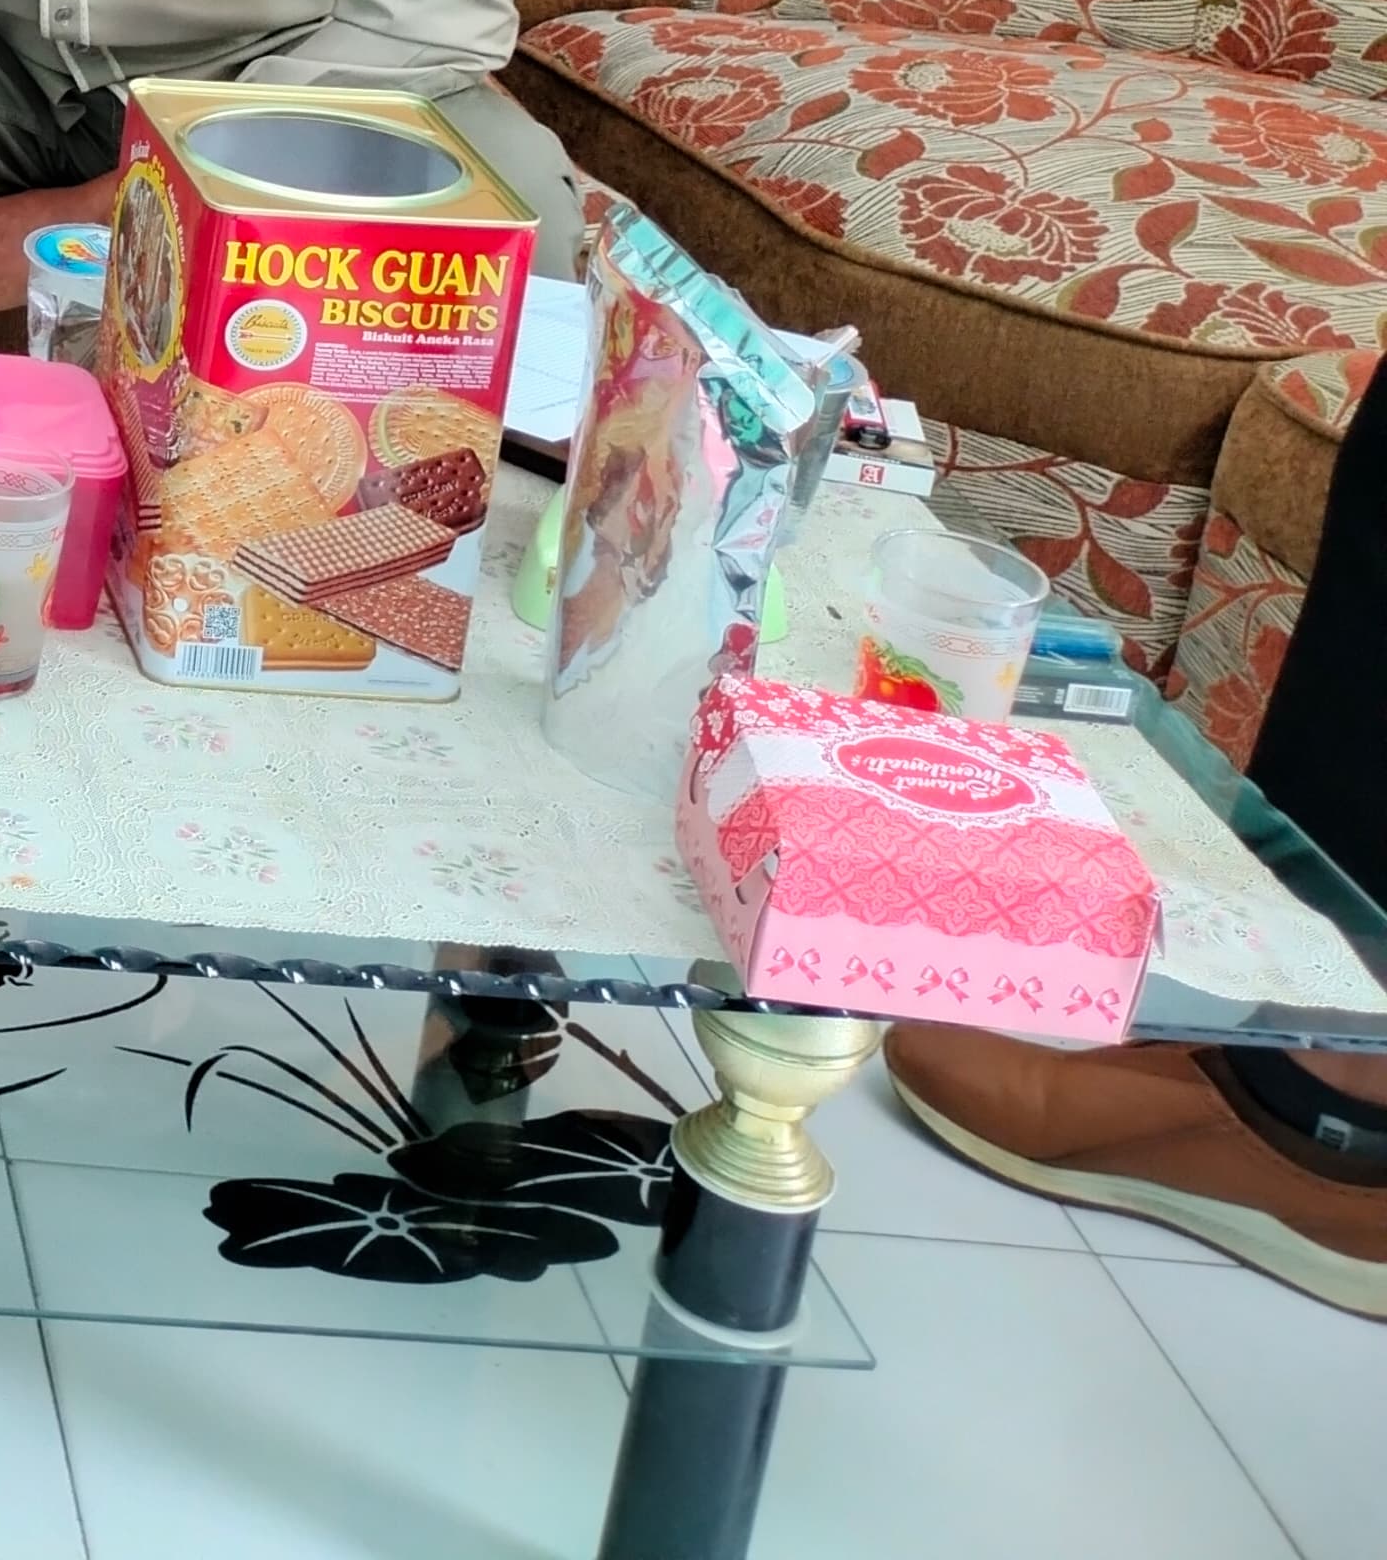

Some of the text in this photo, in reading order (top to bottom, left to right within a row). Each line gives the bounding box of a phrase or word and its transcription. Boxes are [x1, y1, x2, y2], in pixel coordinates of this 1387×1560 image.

[222, 241, 510, 297] HOCK GUAN
[320, 298, 499, 332] BISCUITS
[362, 330, 494, 346] Biskuit Aneka Rasa
[863, 756, 1016, 790] Menikmati
[889, 775, 990, 800] Selamat
